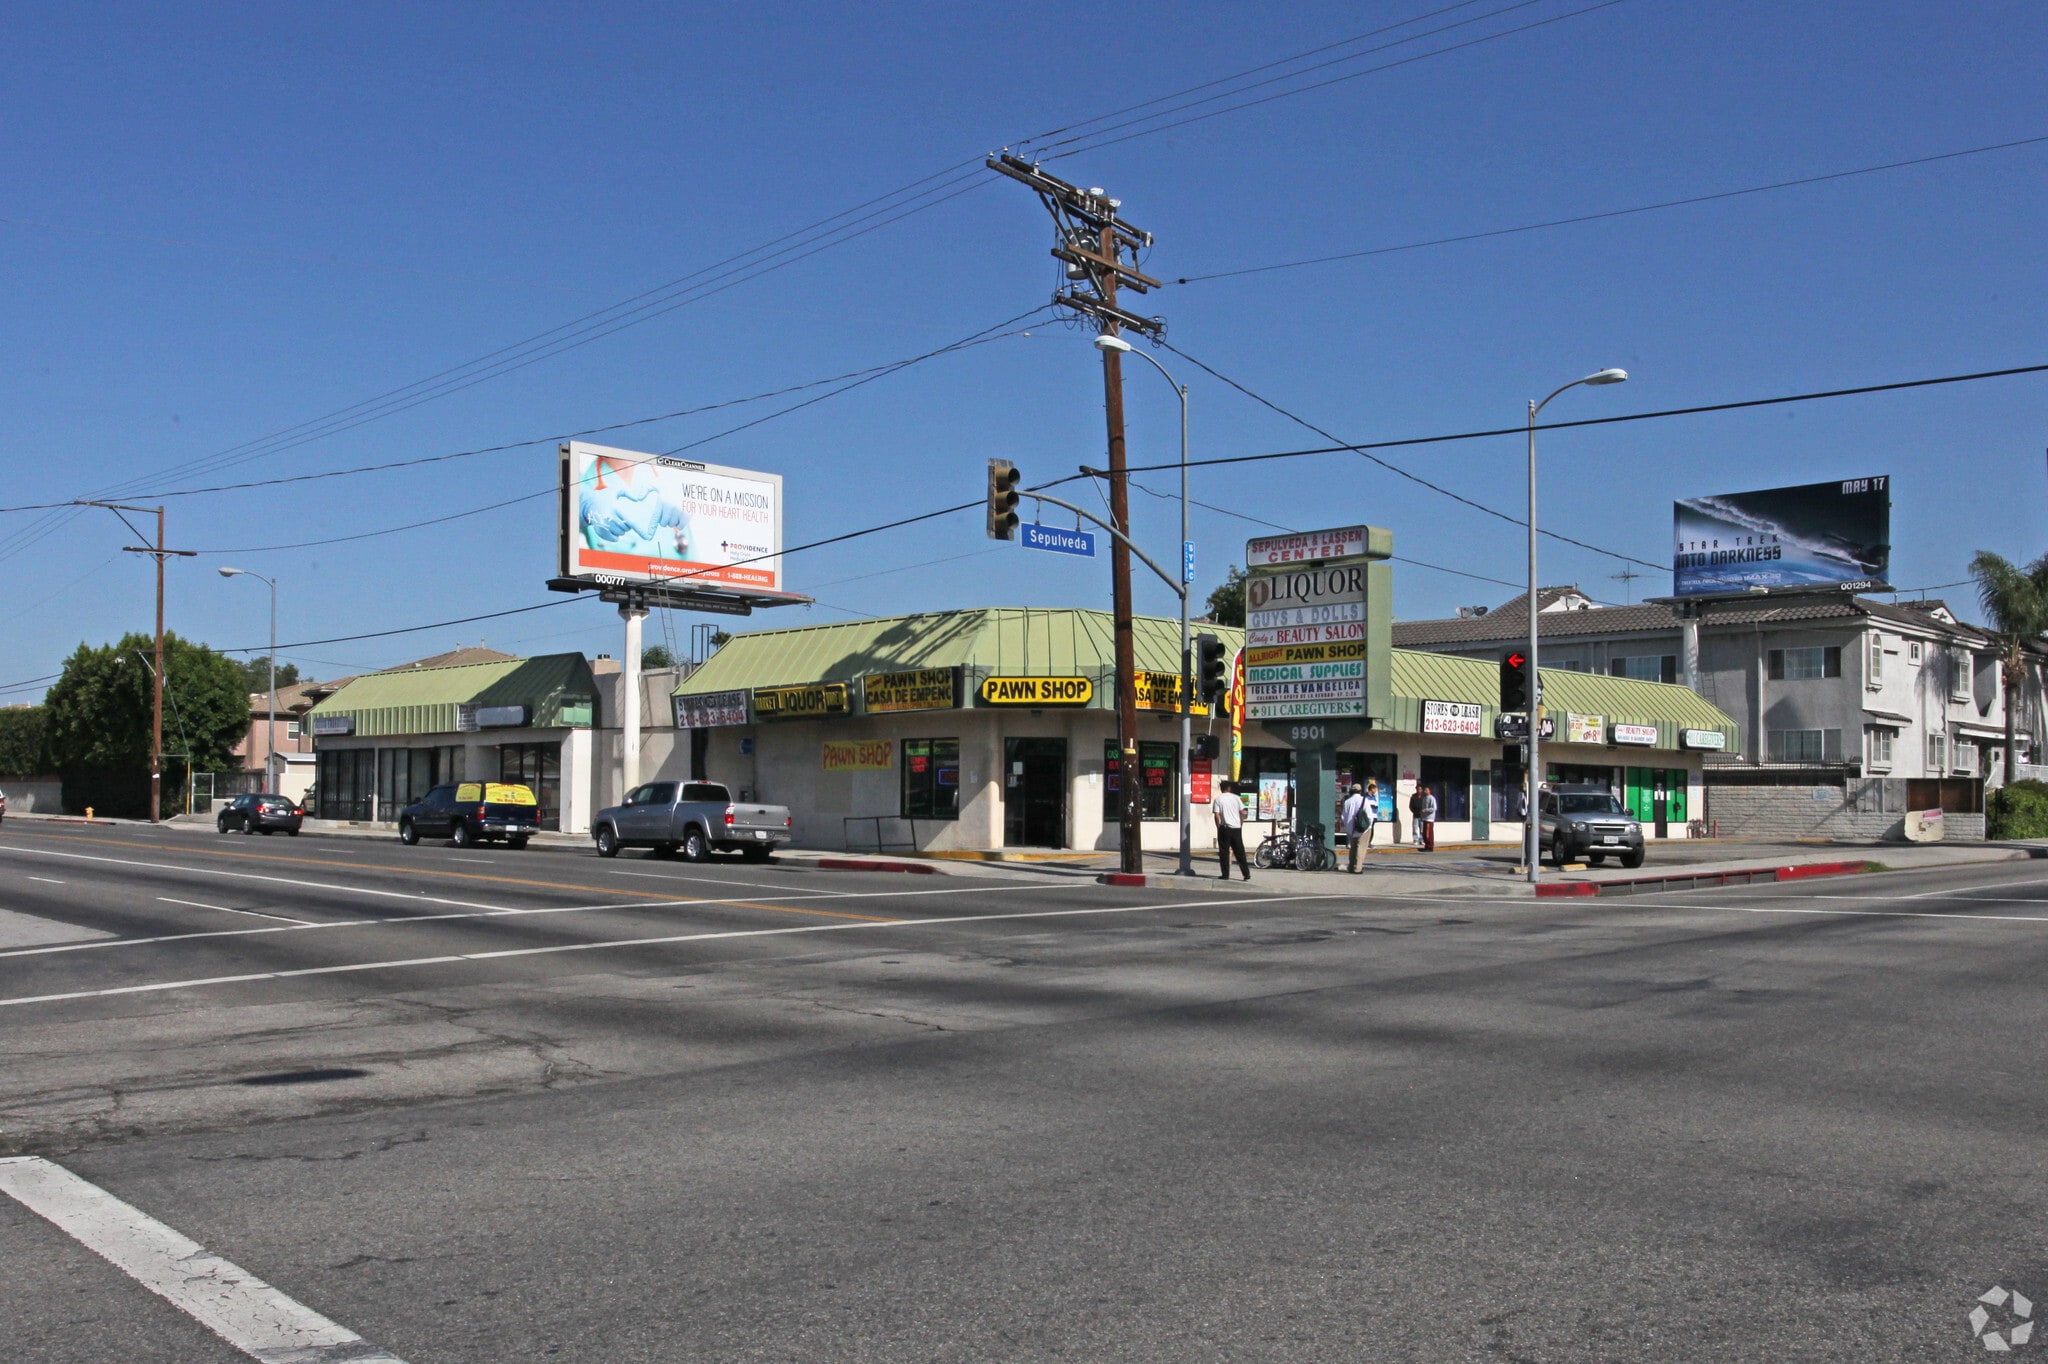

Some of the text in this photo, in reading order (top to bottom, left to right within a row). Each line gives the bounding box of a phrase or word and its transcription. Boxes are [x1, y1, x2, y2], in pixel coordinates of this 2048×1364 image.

[1842, 477, 1885, 495] MAY 17
[682, 483, 769, 509] WE'RE ON A MISSION
[682, 500, 769, 524] FOR YOUR HEART HEALTH
[730, 543, 768, 553] PROVIDENCE
[1030, 529, 1087, 550] Sepulveda
[1252, 530, 1362, 554] SEPULVEDA & LASSEN
[1679, 534, 1778, 552] STAR TREK
[1268, 544, 1345, 562] CENTER
[1677, 545, 1781, 569] INTO DARKNESS
[595, 574, 626, 586] 000777
[1271, 568, 1363, 603] LIQUOR
[1840, 581, 1871, 591] 001294
[1252, 604, 1358, 627] GUYS & DOLLS
[1277, 627, 1320, 644] BEAUTY
[1325, 623, 1365, 640] SALON
[1248, 643, 1366, 663] ALLRIGHT PAWN SHOP
[883, 672, 916, 689] PAWN
[1144, 672, 1177, 688] PAWN
[1249, 662, 1362, 682] MEDICAL SUPPLIES
[867, 690, 893, 704] CASA
[895, 689, 908, 703] DE
[988, 680, 1087, 700] PAWN SHOP
[1154, 689, 1166, 704] DE
[1251, 681, 1360, 695] IGLESIA EVANGELICA
[777, 690, 826, 712] LIQUOR
[1261, 702, 1351, 716] 911 CAREGIVERS
[1426, 702, 1448, 716] STORES
[1461, 705, 1479, 718] LEASE
[1292, 726, 1325, 740] 9901
[1425, 718, 1480, 733] 213-623-6404
[823, 741, 891, 767] PAWN SHOP
